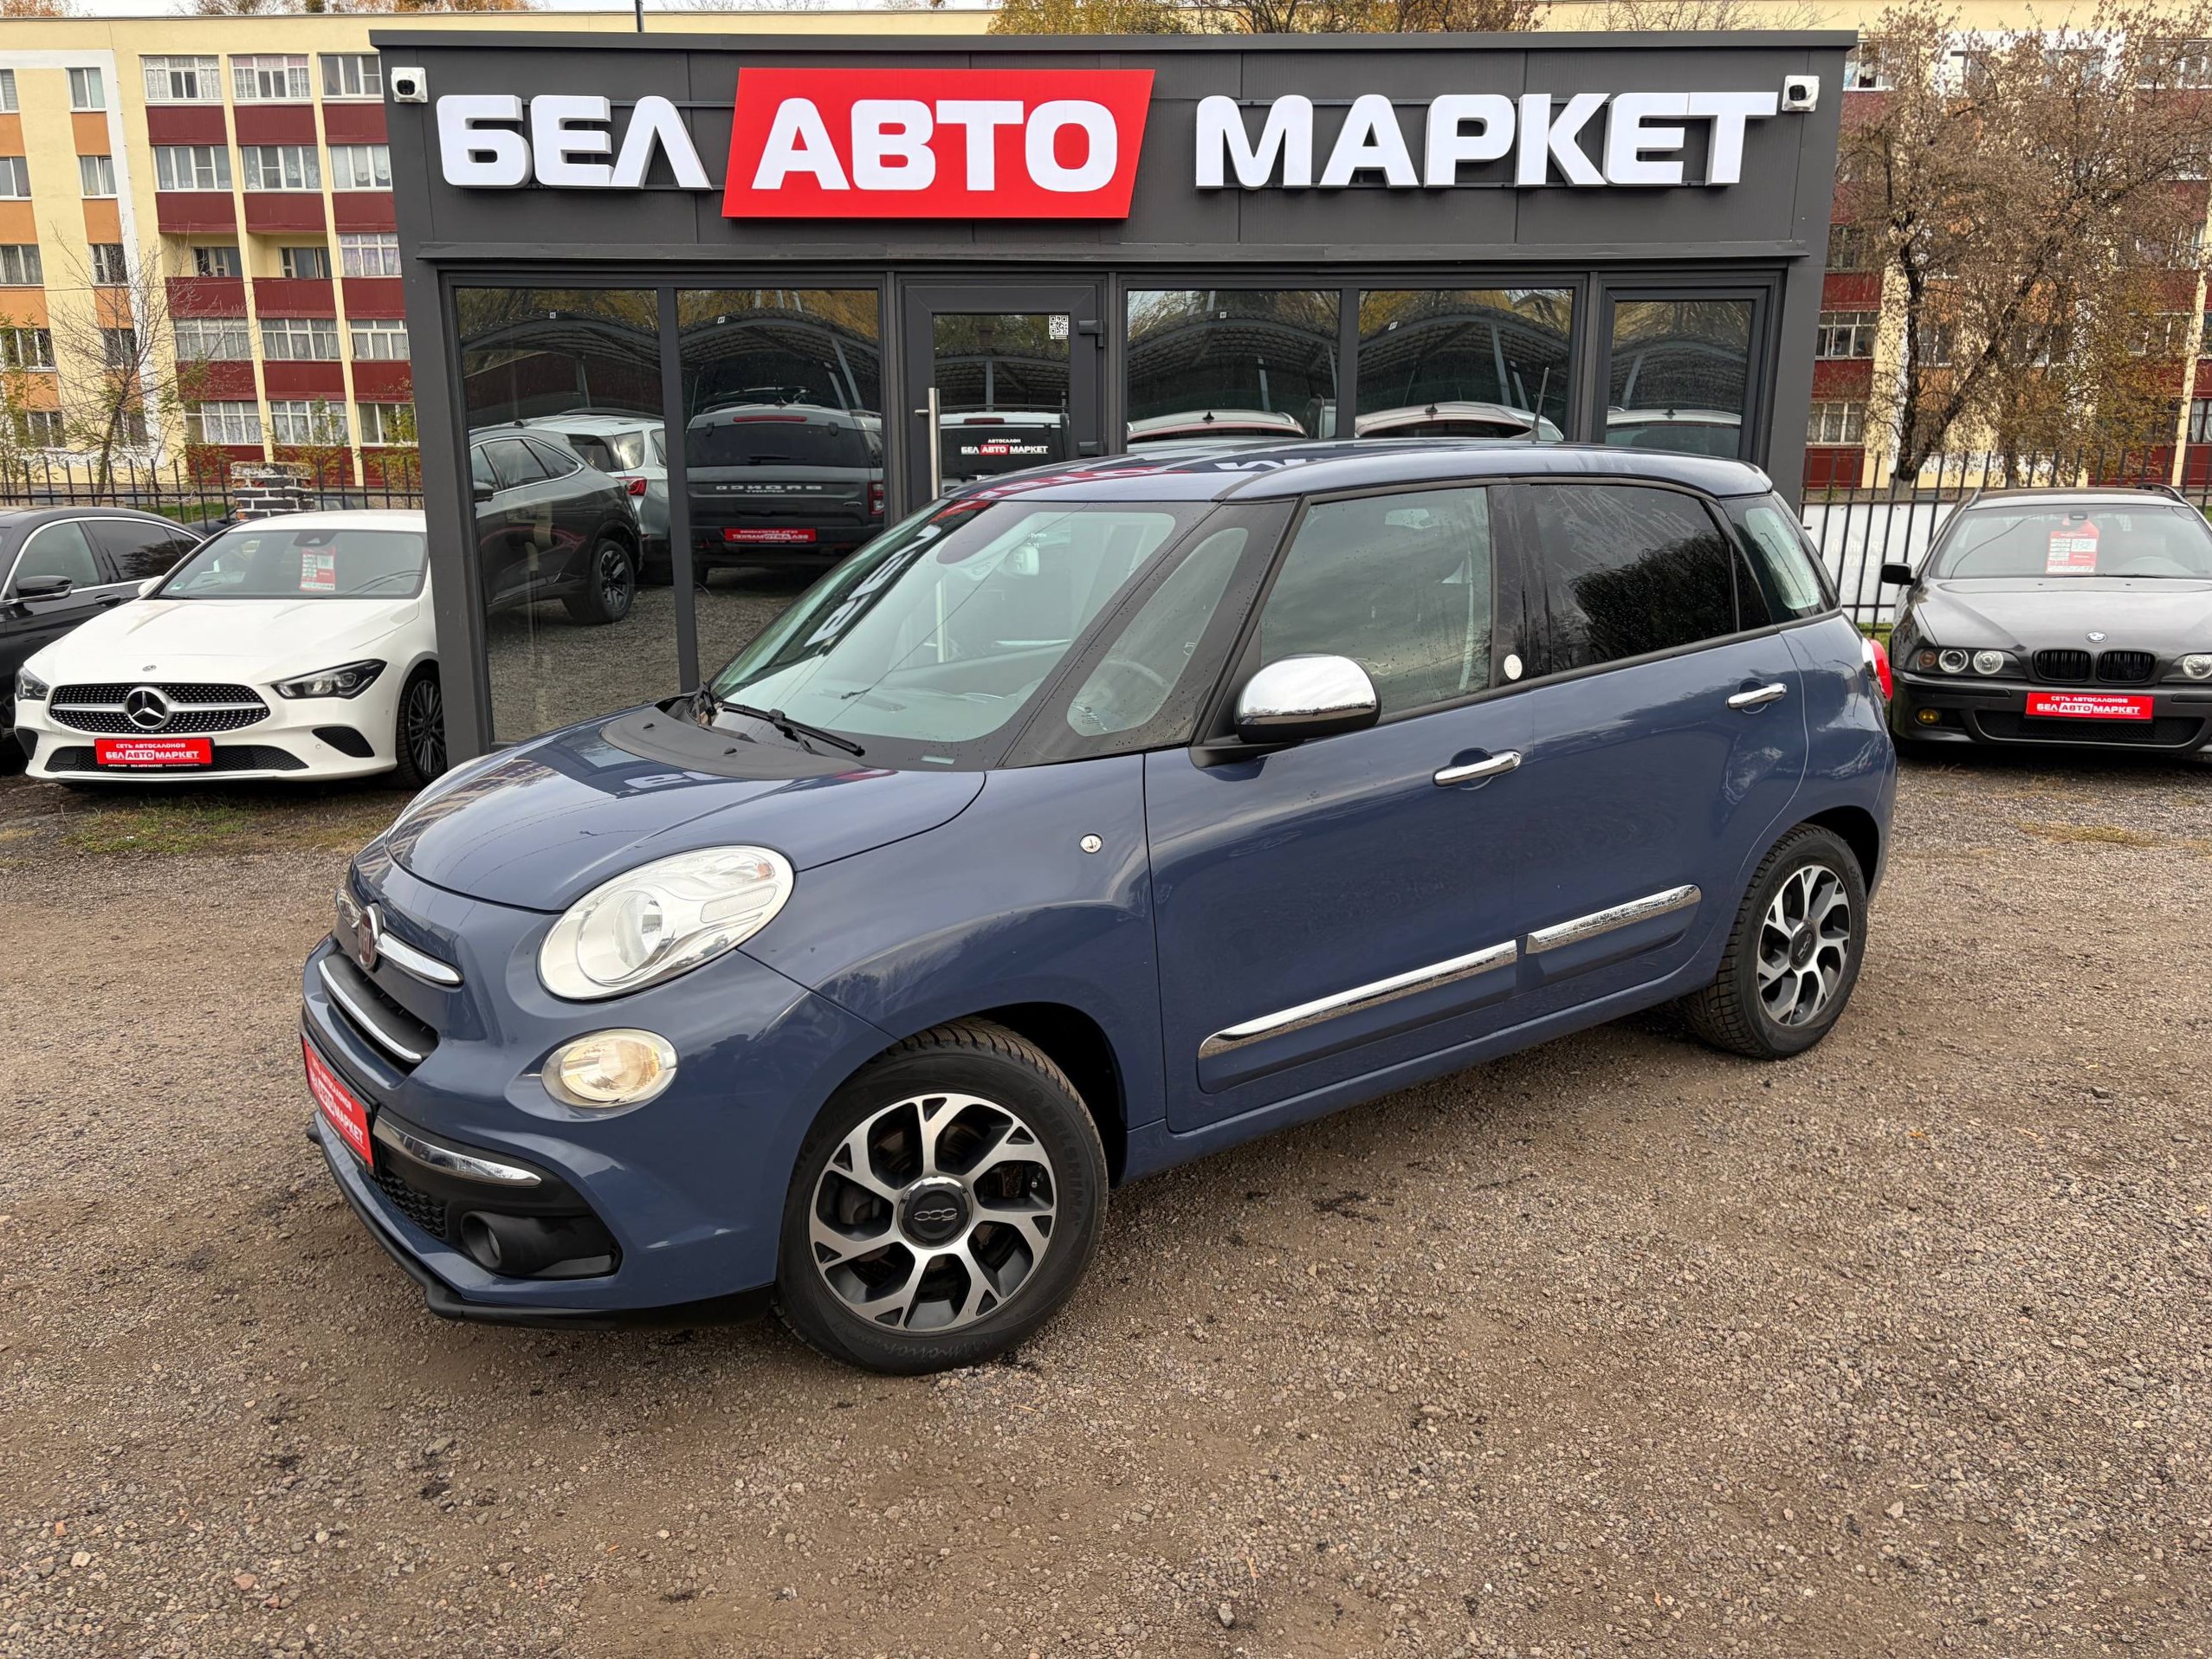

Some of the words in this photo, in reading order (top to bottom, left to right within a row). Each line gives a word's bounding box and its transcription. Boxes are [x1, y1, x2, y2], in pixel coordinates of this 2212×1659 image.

[437, 94, 712, 190] БЕЛ
[751, 97, 1118, 192] АВТО
[1194, 92, 1778, 190] МАРКЕТ
[960, 446, 980, 455] БЕЛ
[1010, 445, 1049, 454] МАРКЕТ
[2037, 703, 2058, 712] БЕЛ
[2093, 705, 2140, 714] МАРКЕТ
[156, 751, 199, 759] МАРКЕТ
[334, 1105, 364, 1145] МАРКЕТ
